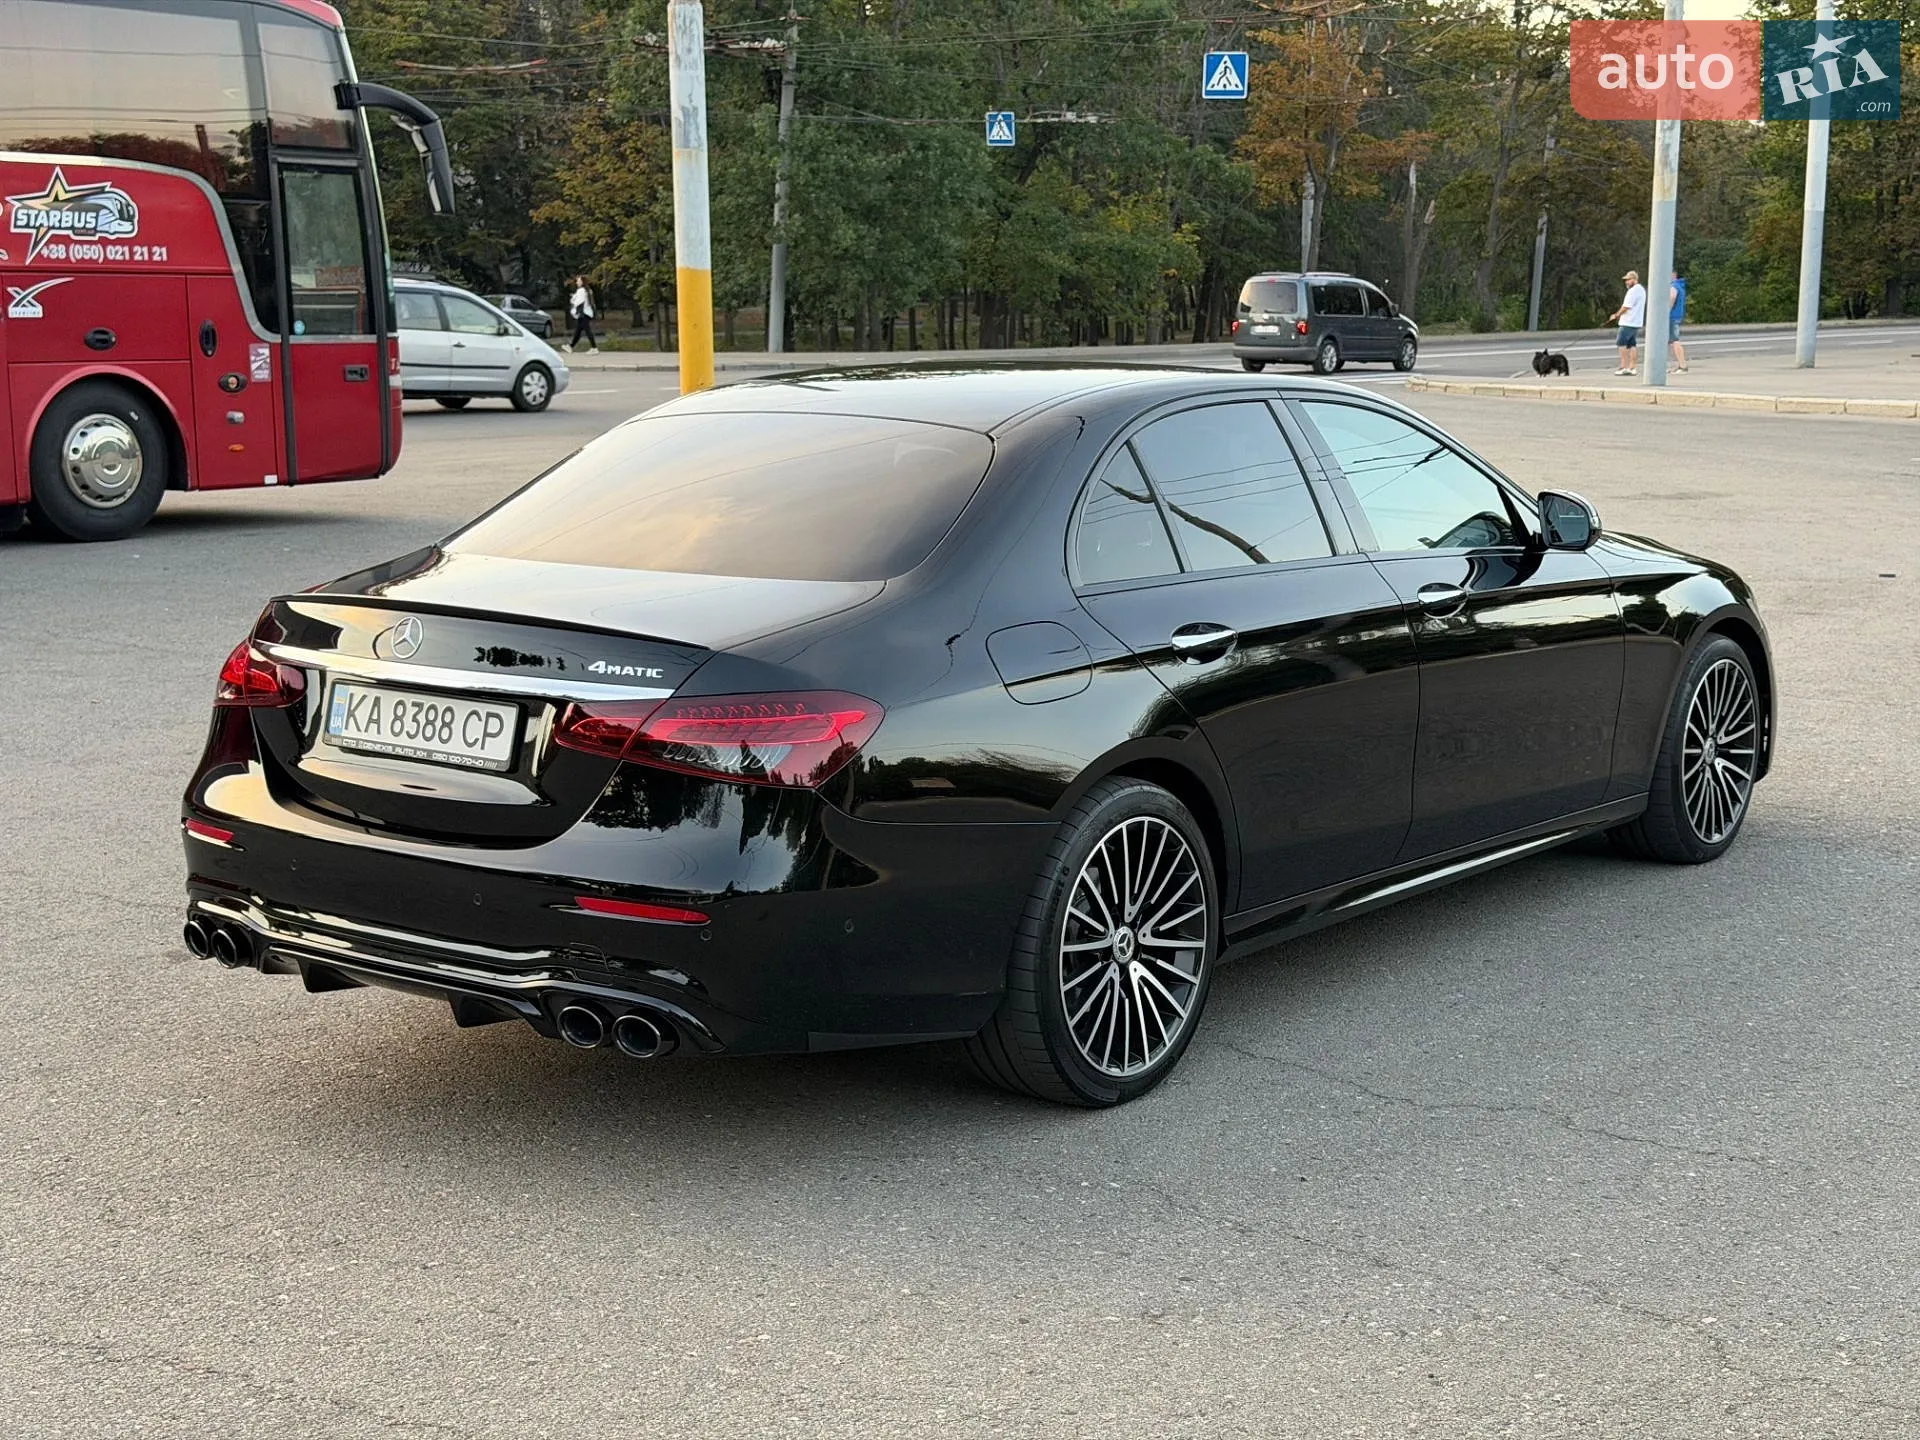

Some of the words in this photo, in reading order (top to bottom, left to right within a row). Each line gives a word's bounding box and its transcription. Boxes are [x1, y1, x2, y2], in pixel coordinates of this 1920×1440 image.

[16, 209, 97, 228] STARBUS
[41, 244, 67, 260] +38
[69, 243, 104, 264] (050)
[106, 245, 130, 261] 021
[133, 246, 149, 261] 21
[152, 246, 168, 262] 21
[588, 660, 664, 678] 4MATIC
[331, 716, 342, 728] UA
[344, 692, 382, 735] KA
[390, 699, 456, 745] 8388
[462, 709, 504, 750] CP
